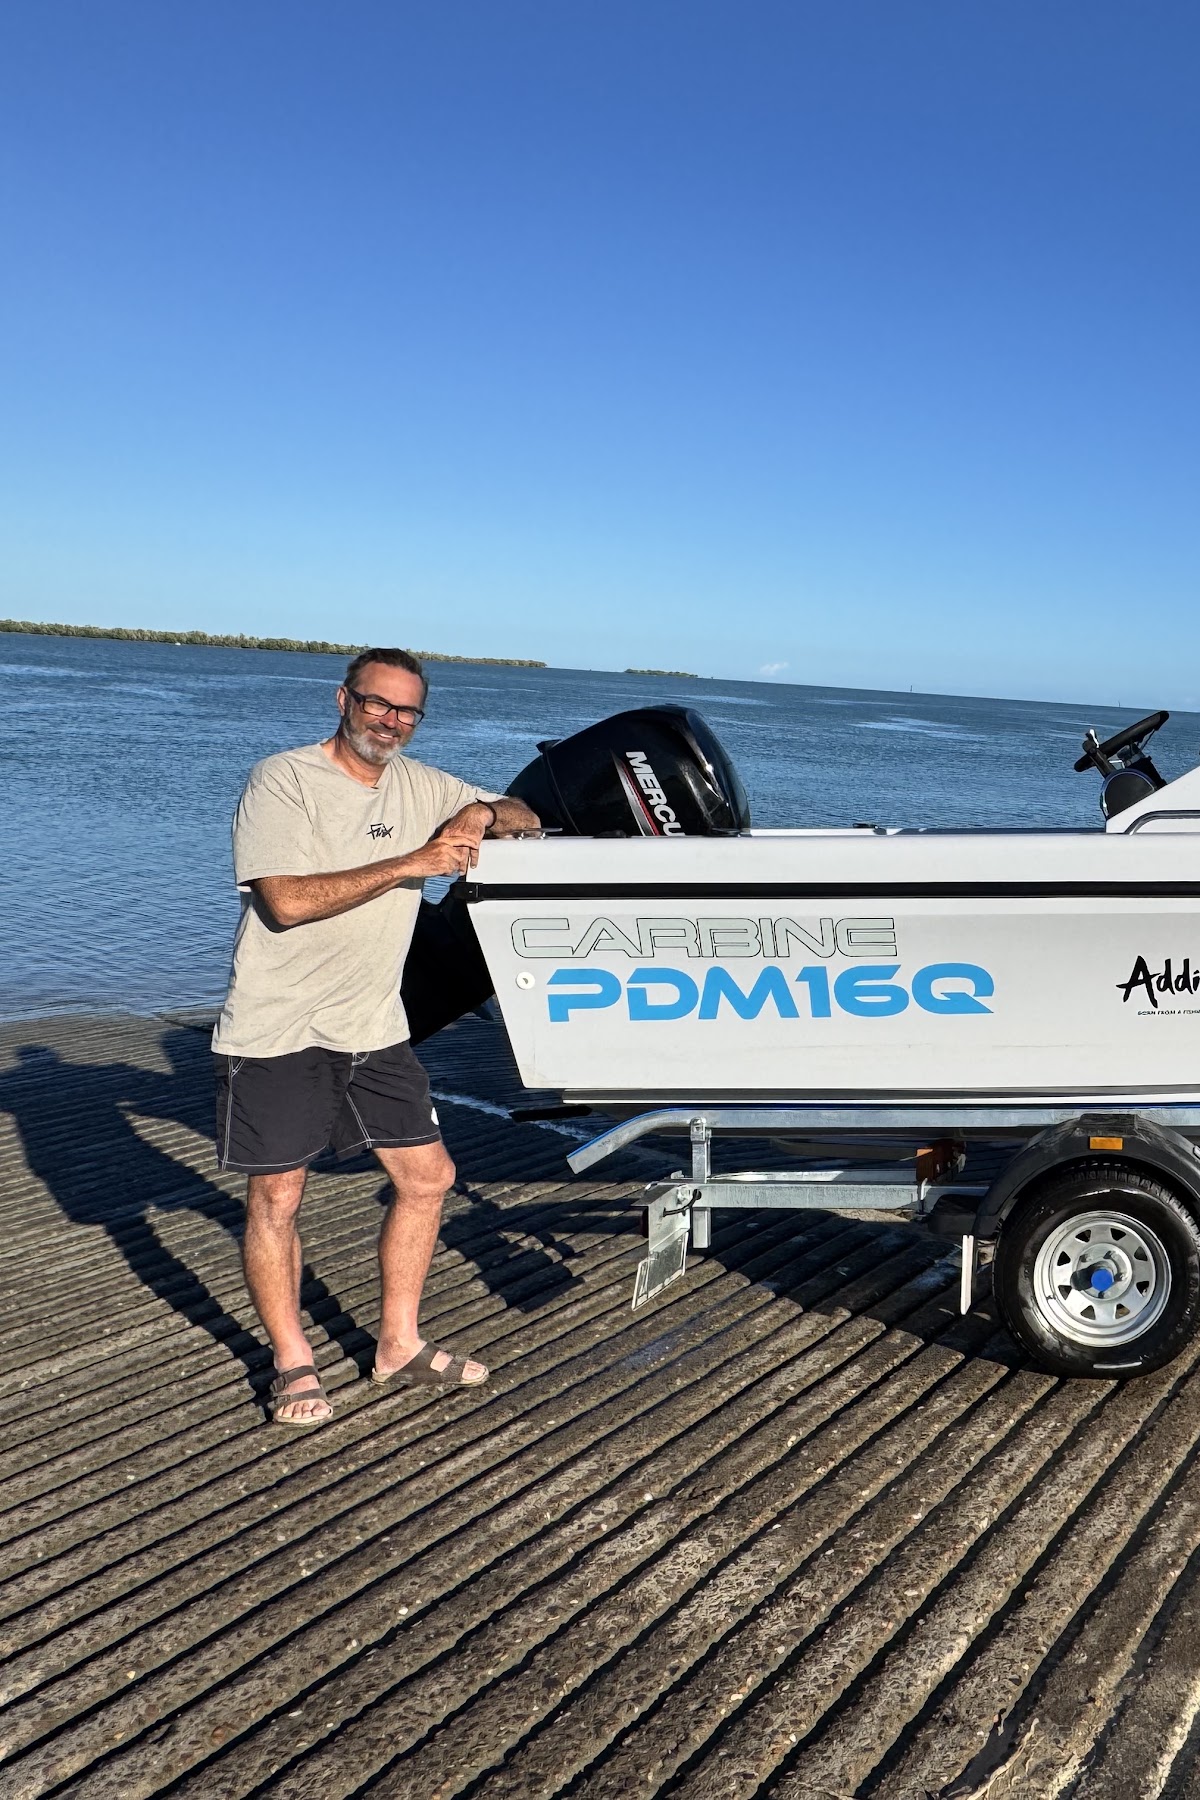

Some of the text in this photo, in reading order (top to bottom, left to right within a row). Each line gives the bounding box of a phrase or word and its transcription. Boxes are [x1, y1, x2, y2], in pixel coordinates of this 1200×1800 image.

[625, 751, 686, 836] MERCU
[511, 917, 898, 959] CARBINE
[547, 962, 995, 1022] PDM16Q
